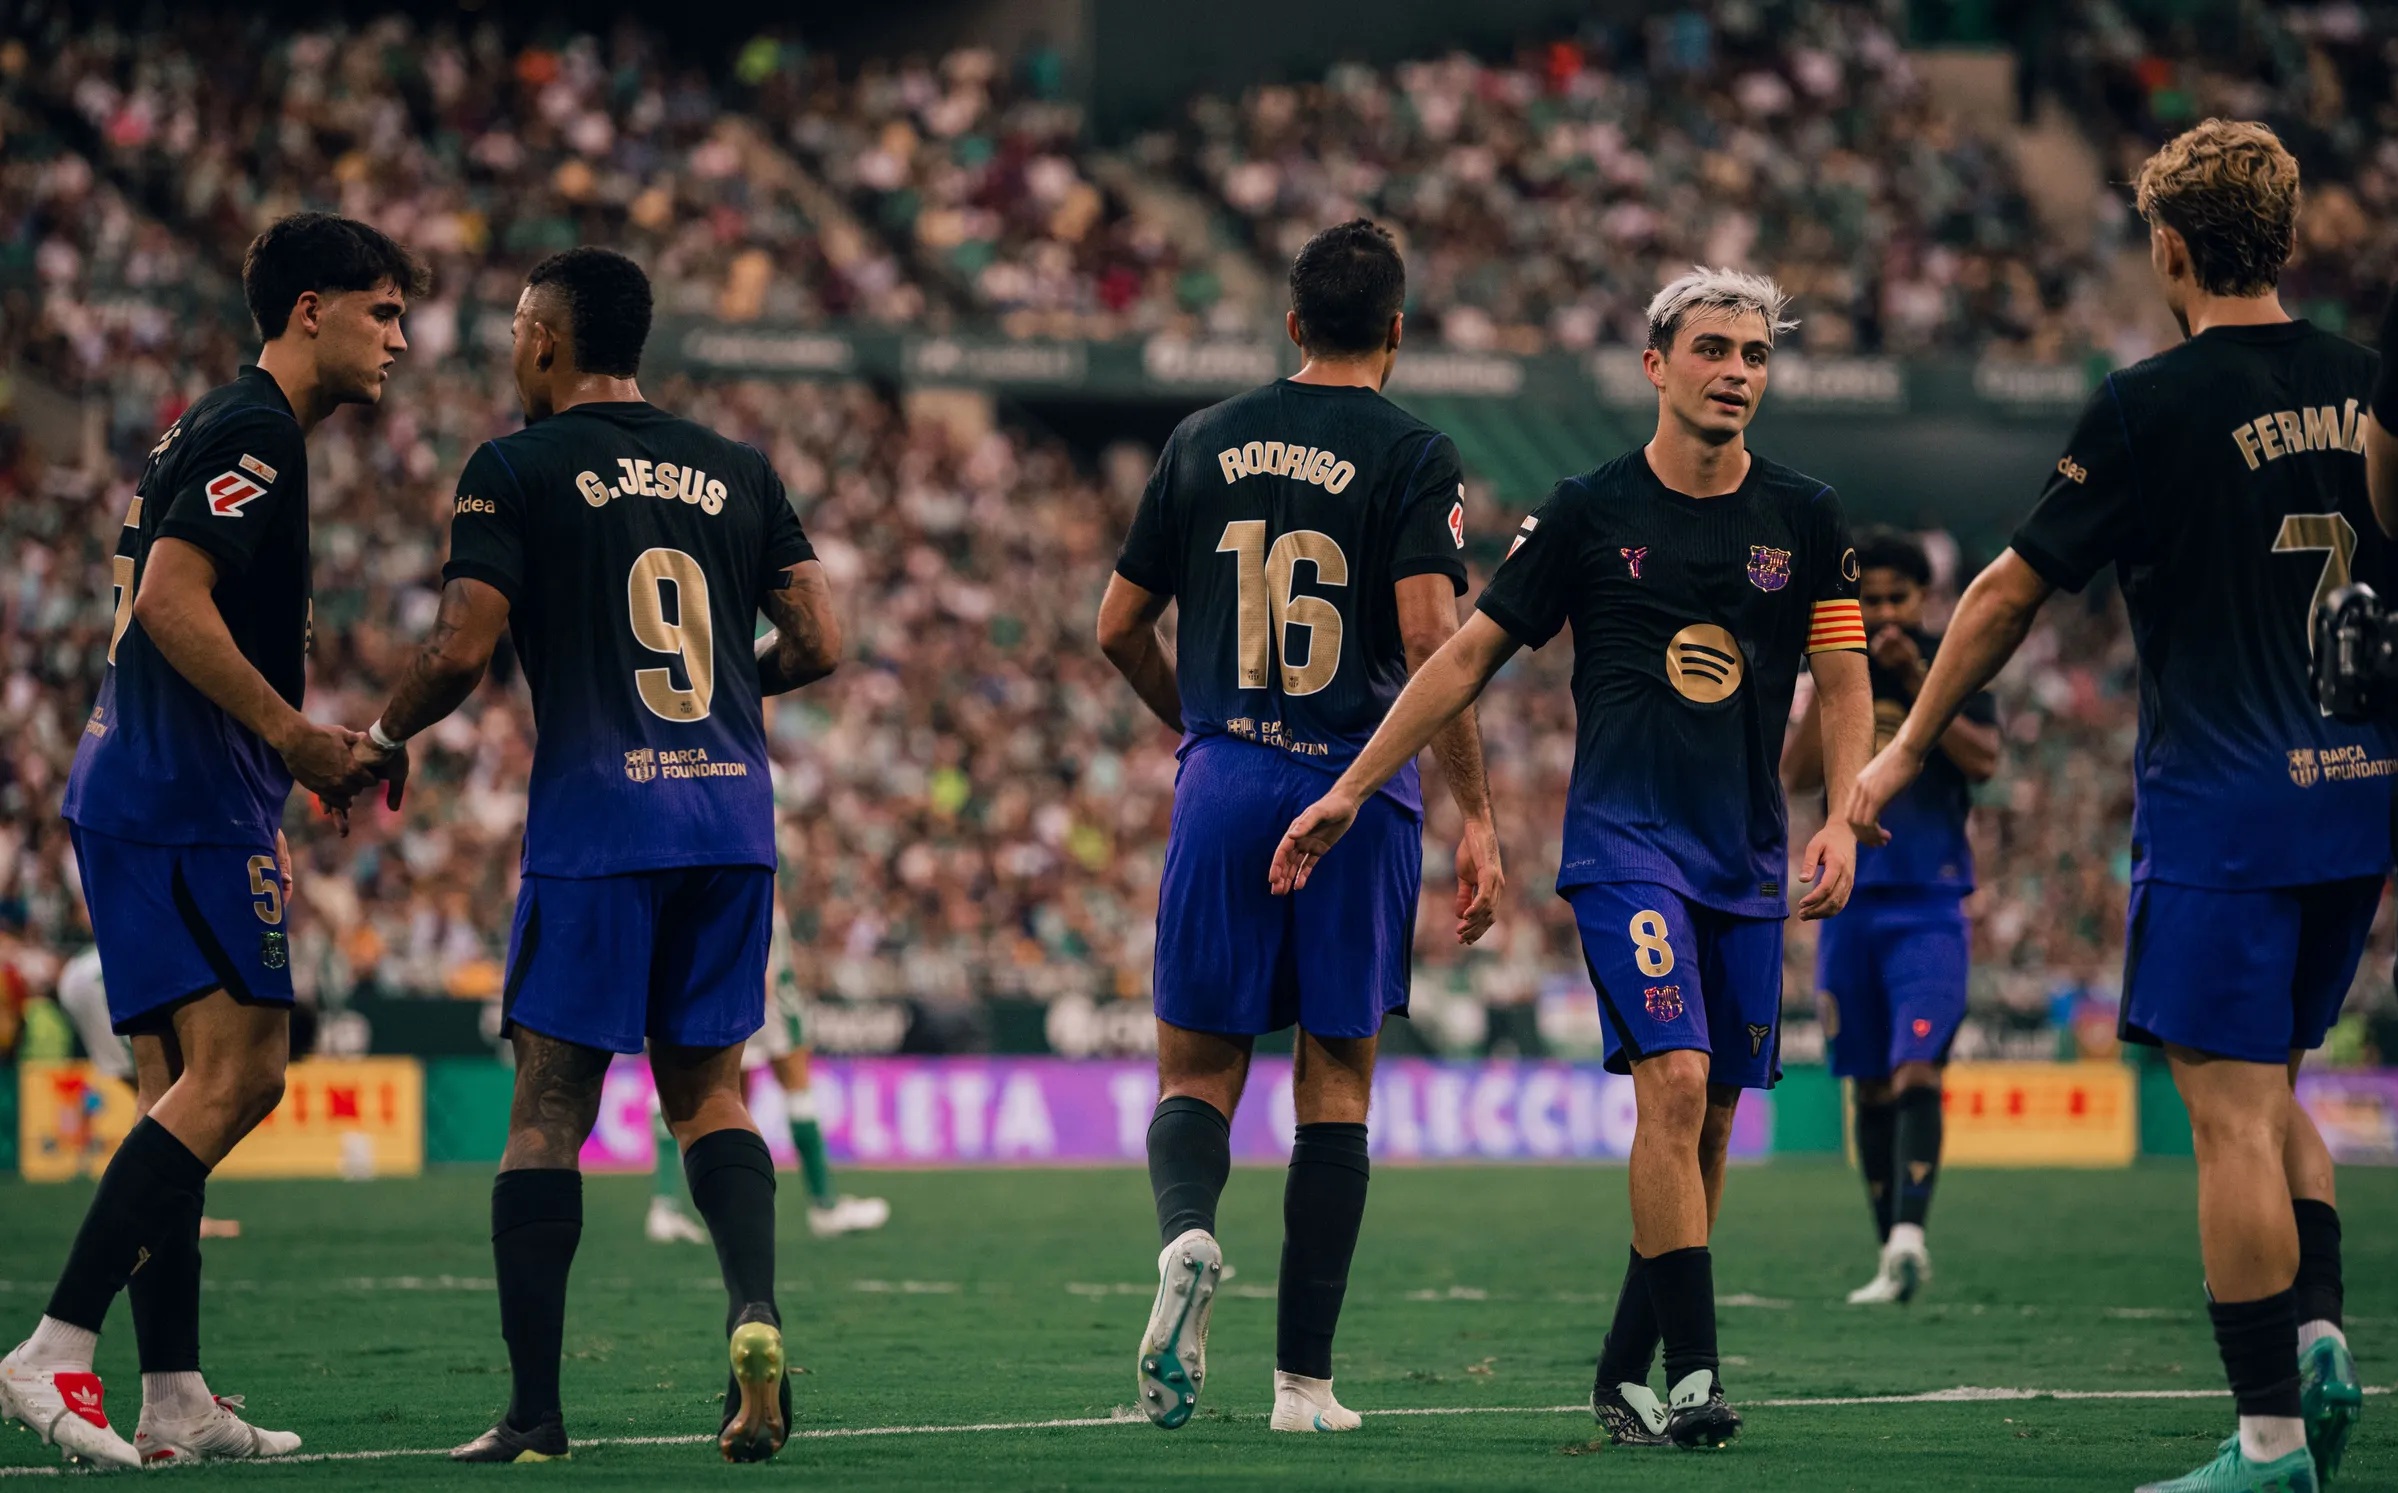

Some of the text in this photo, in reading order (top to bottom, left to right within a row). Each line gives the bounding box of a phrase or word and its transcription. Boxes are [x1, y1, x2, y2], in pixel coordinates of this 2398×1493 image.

[575, 457, 727, 516] G.JESUS
[1218, 441, 1356, 494] RODRIGO
[2057, 455, 2087, 484] dea
[452, 494, 496, 517] idea
[627, 547, 714, 723] 9
[1215, 519, 1349, 696] 16
[2271, 511, 2358, 717] 7
[658, 749, 708, 765] BARÇA
[661, 762, 748, 779] FOUNDATION
[2319, 745, 2367, 765] BARÇA
[246, 855, 283, 925] 5
[1629, 909, 1675, 977] 8
[1107, 1071, 1158, 1160] T
